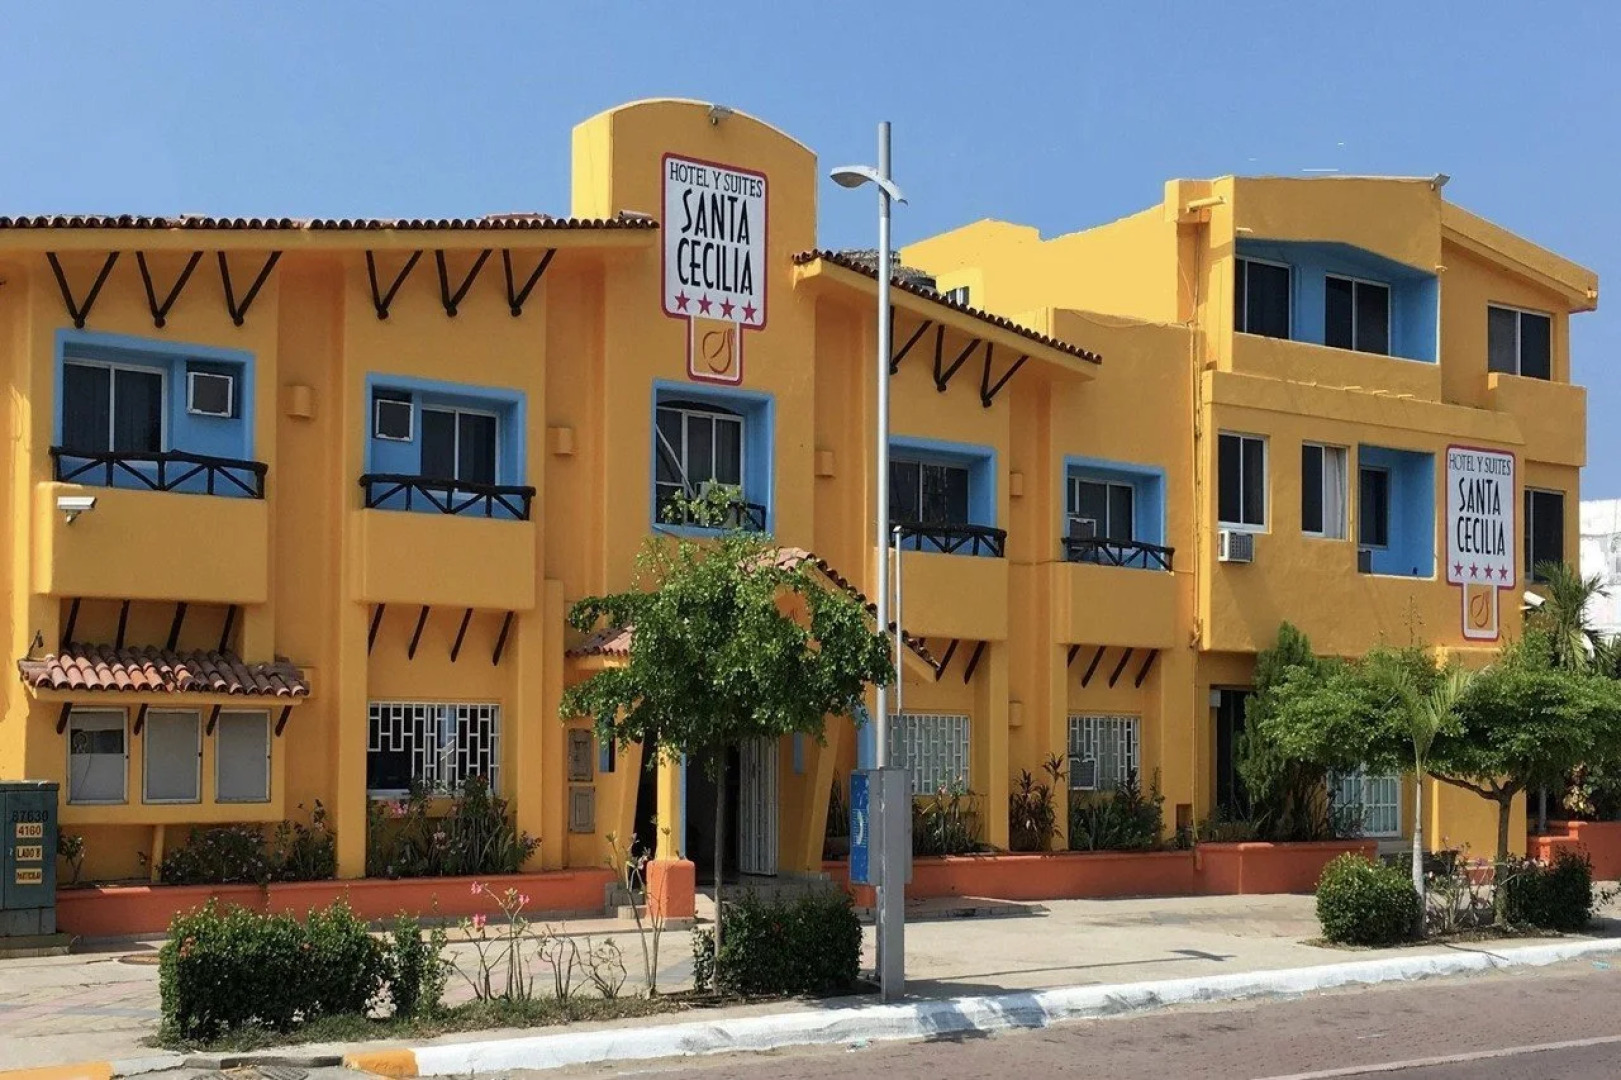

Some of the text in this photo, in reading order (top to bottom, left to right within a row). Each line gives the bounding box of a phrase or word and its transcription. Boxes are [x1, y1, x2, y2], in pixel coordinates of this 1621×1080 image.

[670, 162, 763, 198] HOTEL Y SUITES
[681, 188, 750, 245] SANTA
[677, 238, 753, 295] CECILIA
[1449, 453, 1511, 476] HOTEL Y SUITES
[1459, 477, 1501, 515] SANTA
[1457, 516, 1506, 556] CECILIA
